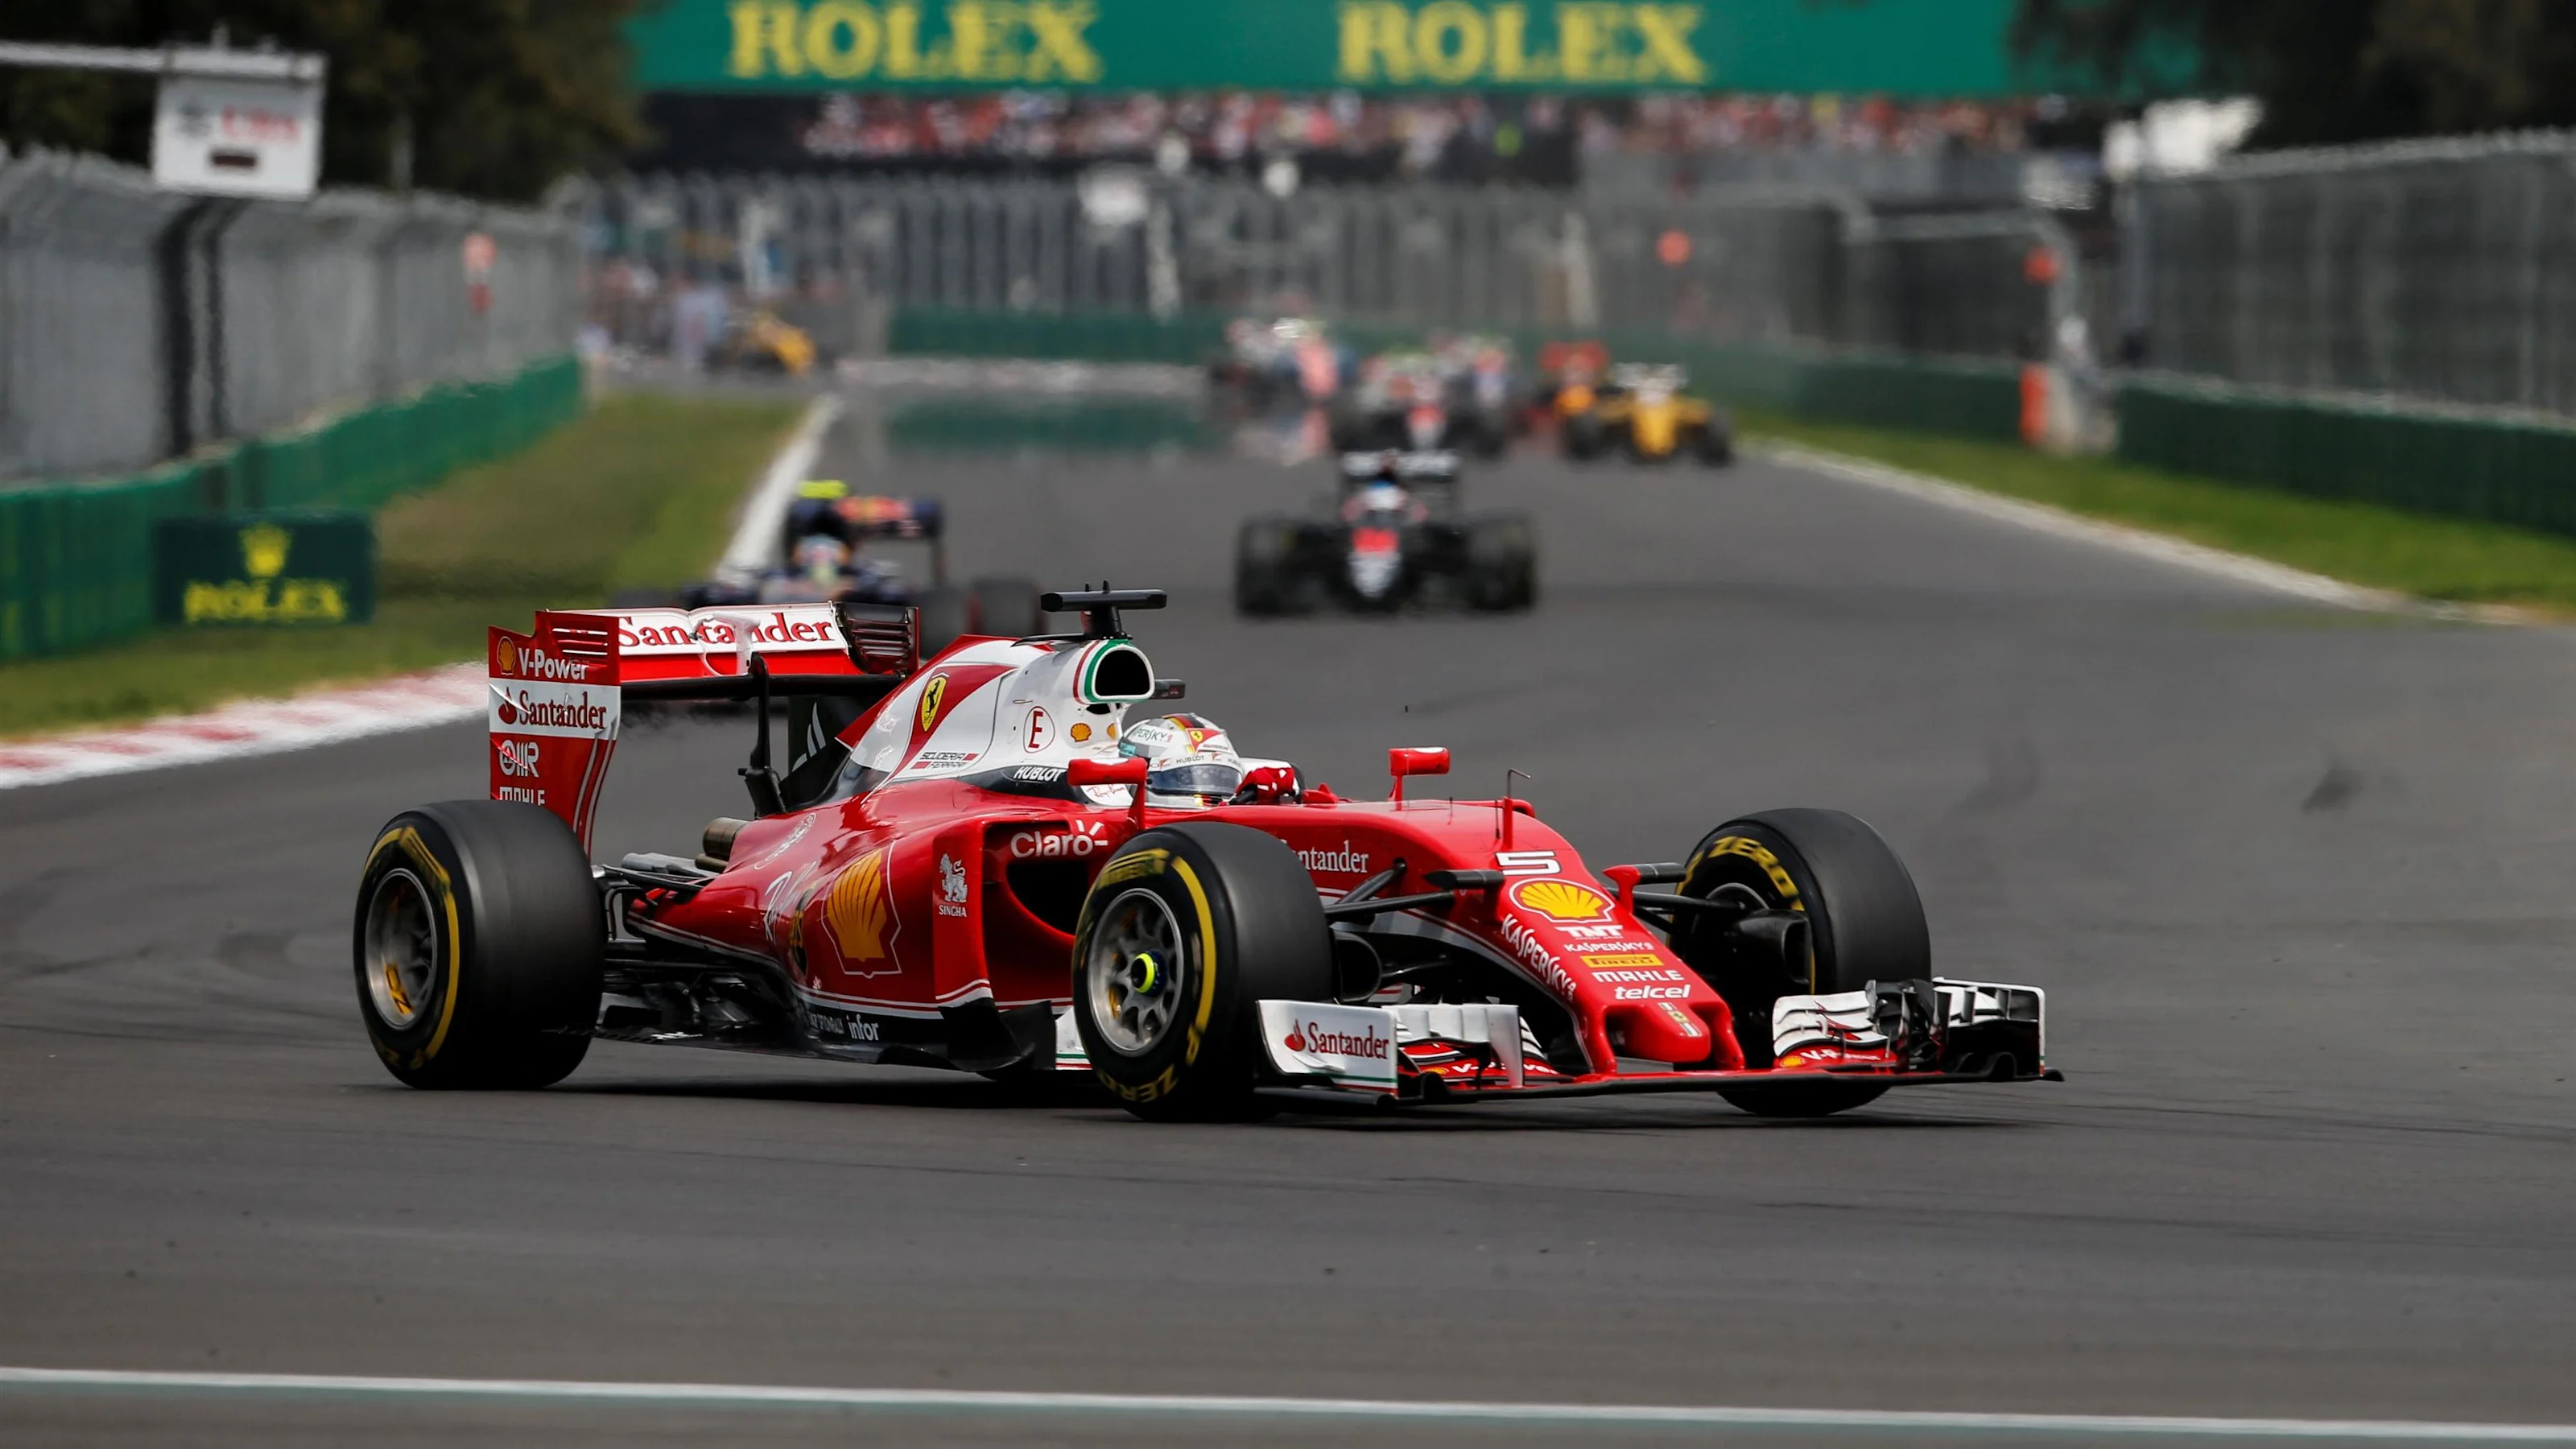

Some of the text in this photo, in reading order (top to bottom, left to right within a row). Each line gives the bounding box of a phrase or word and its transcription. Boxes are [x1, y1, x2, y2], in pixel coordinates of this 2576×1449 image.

[726, 0, 1103, 79] ROLEX
[1338, 2, 1705, 80] ROLEX
[518, 647, 588, 680] V-Power
[519, 689, 607, 729] Santander
[1013, 766, 1068, 782] HUBLOT
[1010, 830, 1096, 858] Claro
[1293, 840, 1369, 873] ntander
[1495, 850, 1561, 876] 5
[1554, 925, 1624, 937] TNT
[1501, 913, 1572, 997] KASPERSKY
[1563, 941, 1644, 952] KASPERSKY
[1591, 969, 1685, 983] MAHLE
[1614, 984, 1691, 1000] telcel
[845, 1013, 880, 1041] infor
[1307, 1022, 1390, 1059] Santander
